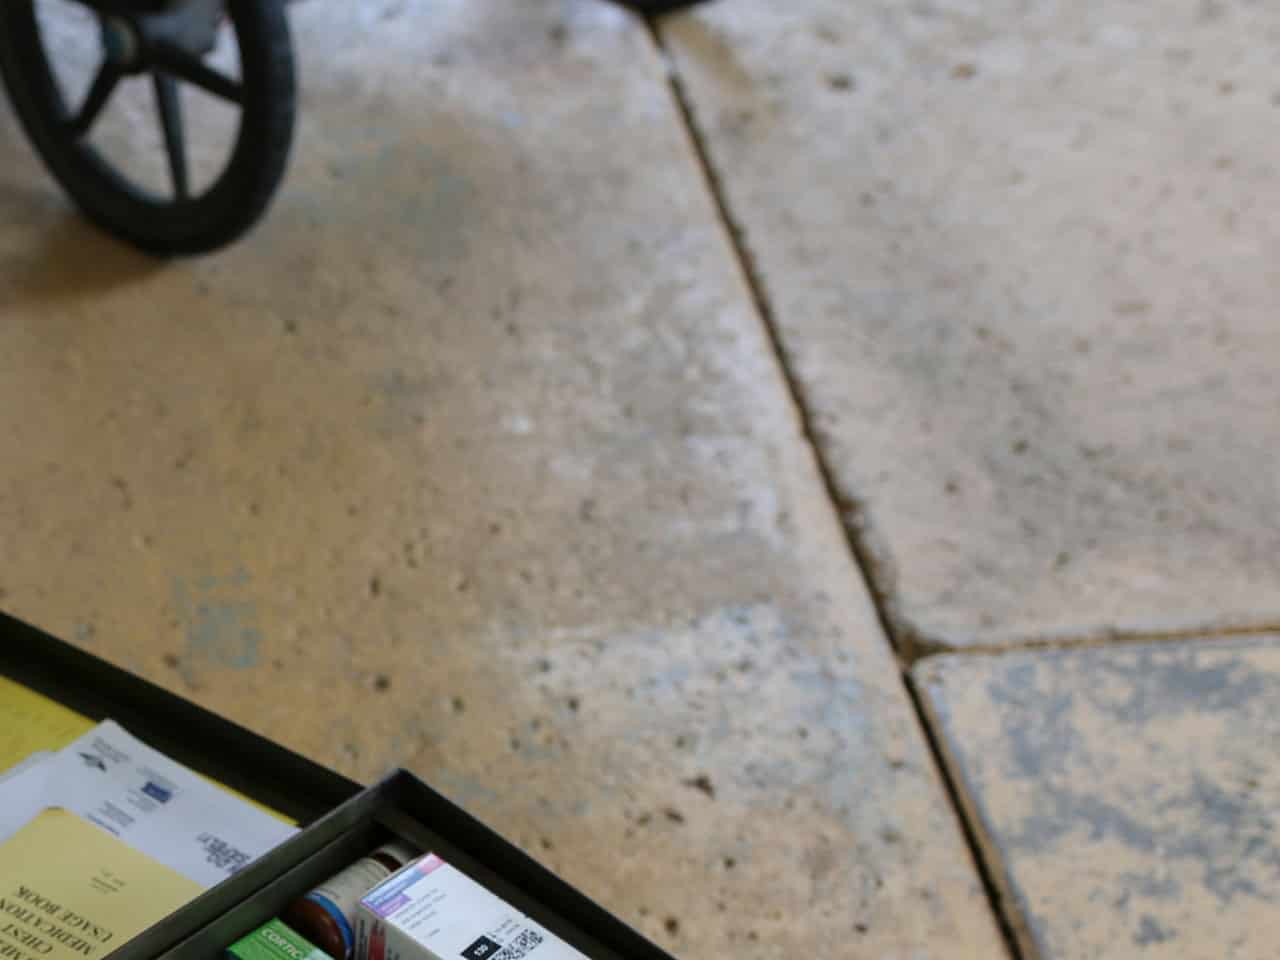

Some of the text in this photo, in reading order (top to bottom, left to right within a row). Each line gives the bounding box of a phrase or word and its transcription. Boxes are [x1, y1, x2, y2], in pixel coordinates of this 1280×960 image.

[17, 885, 113, 943] USAGE BOOK
[0, 923, 53, 955] CHEST
